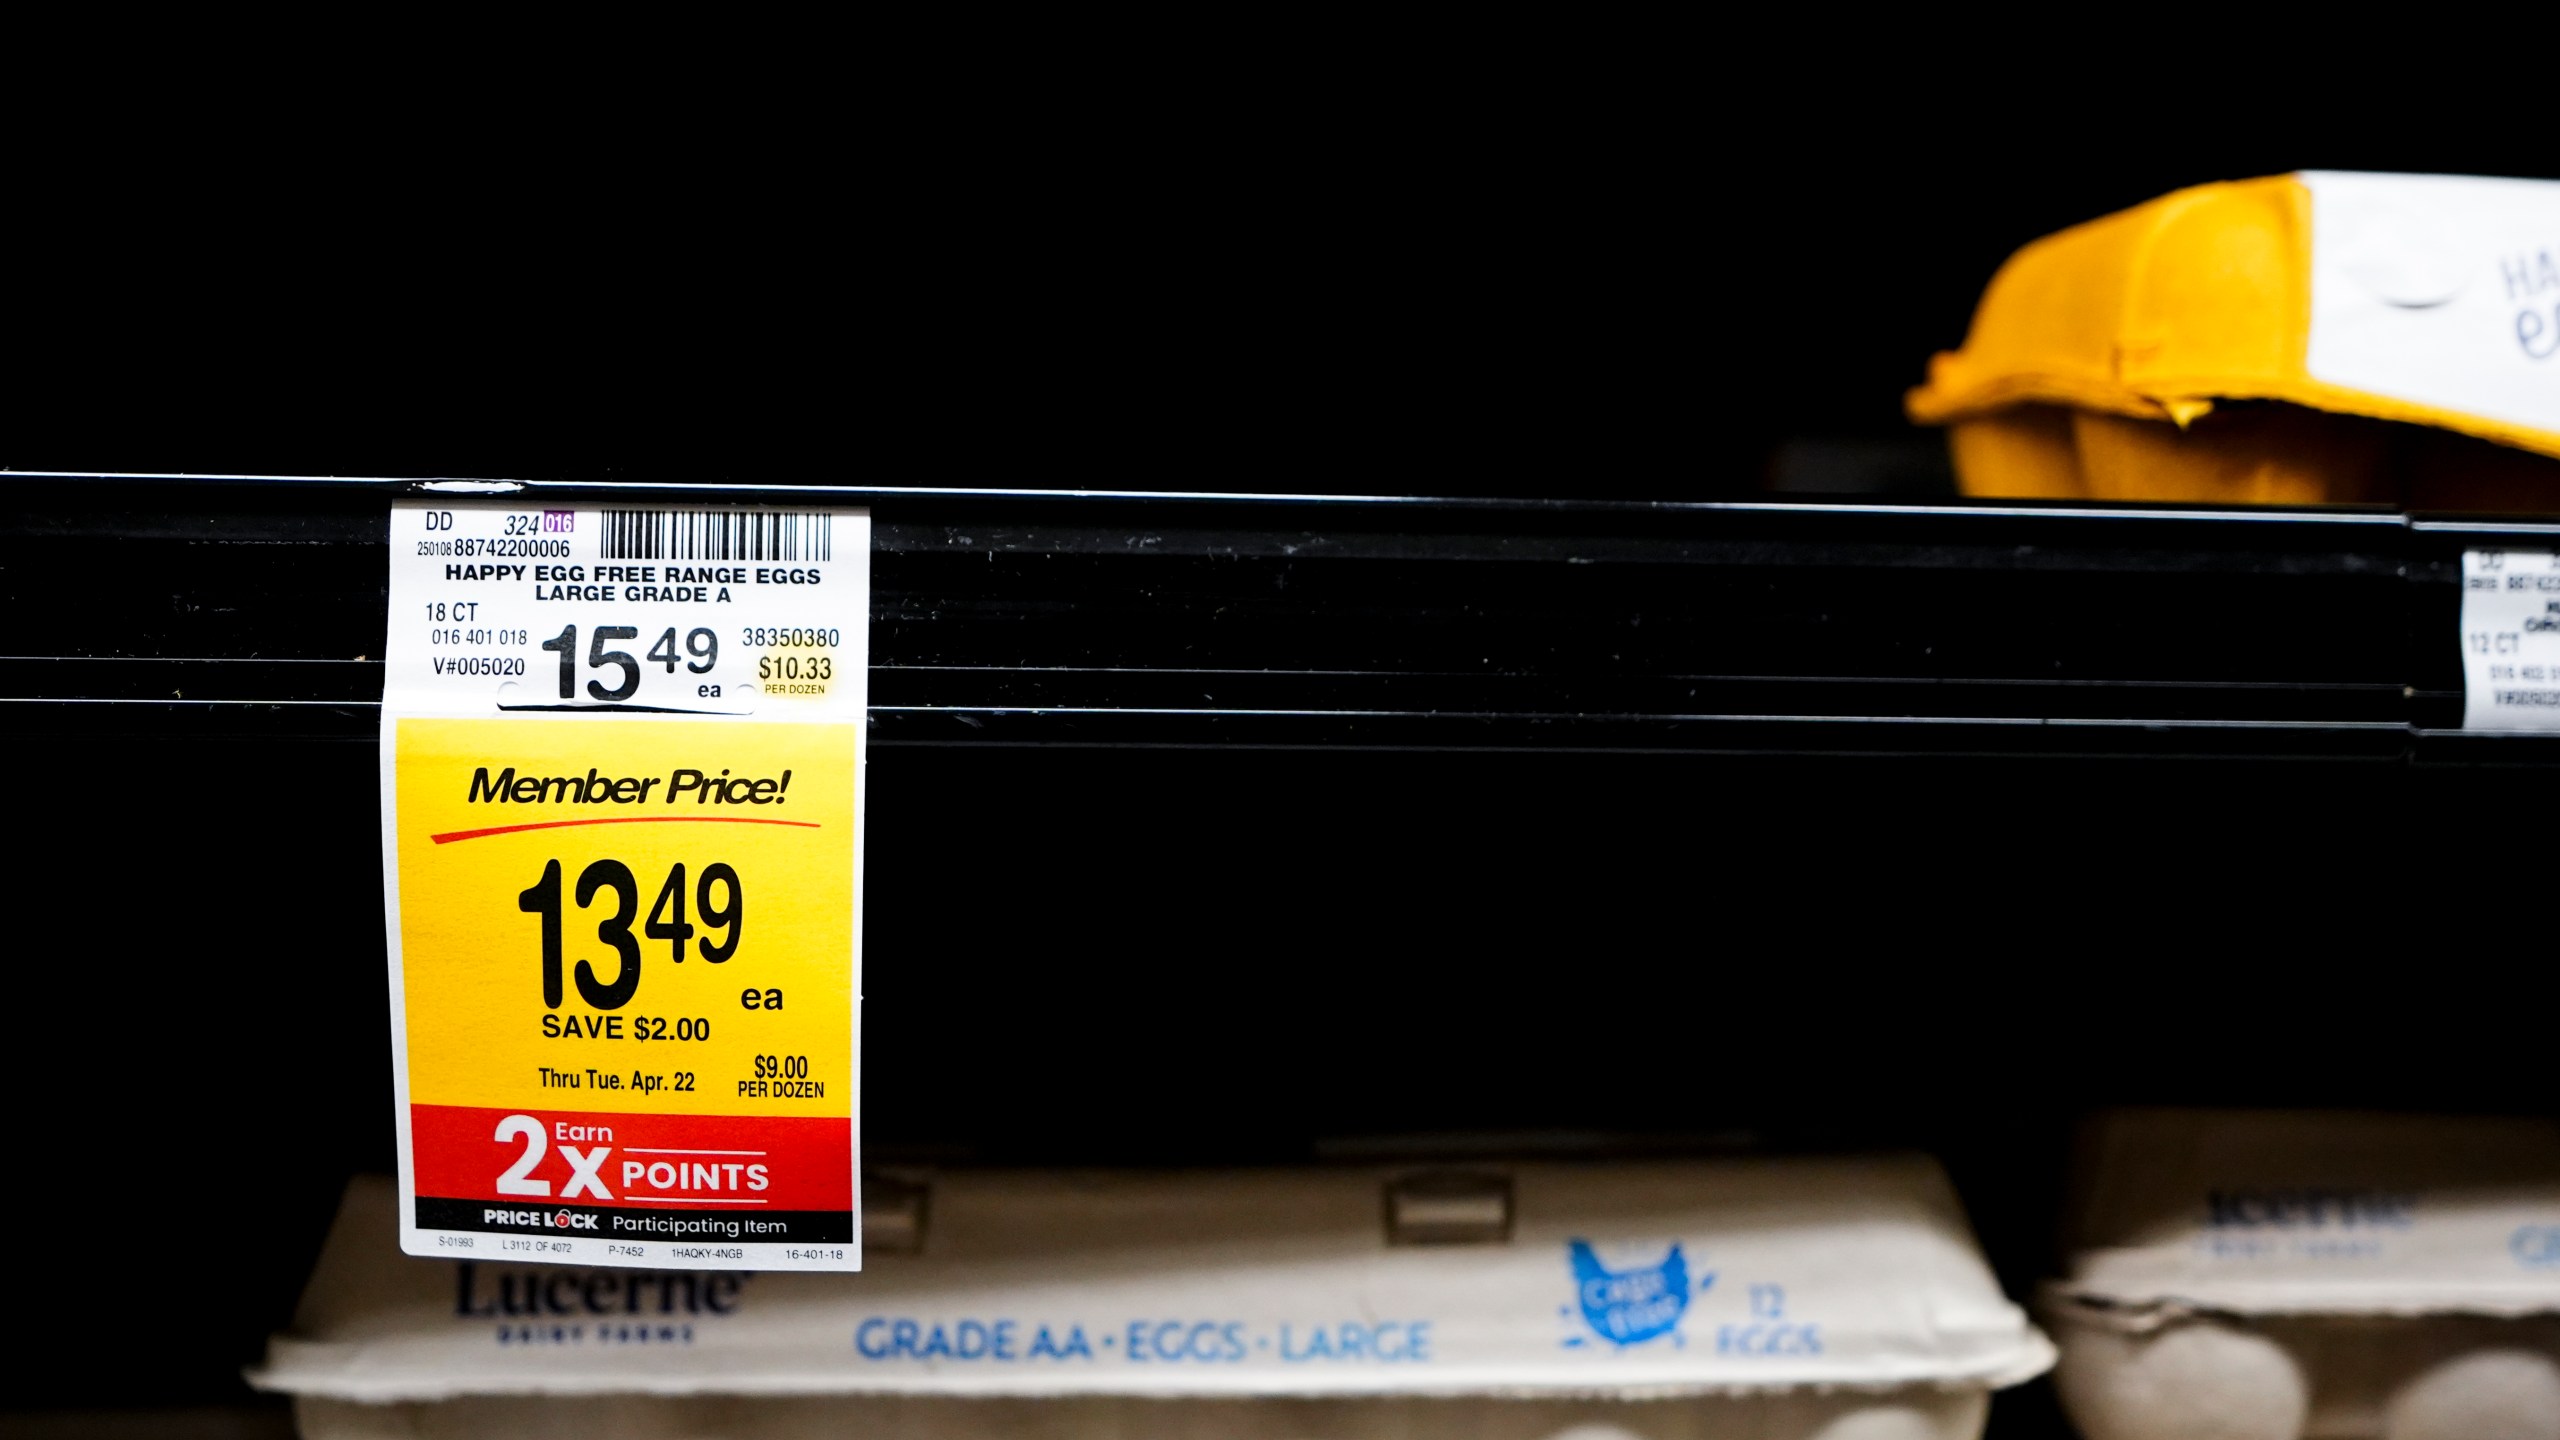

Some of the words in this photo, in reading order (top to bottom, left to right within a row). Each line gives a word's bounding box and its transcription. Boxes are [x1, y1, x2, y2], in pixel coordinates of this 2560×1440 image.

[426, 511, 453, 531] DD
[504, 515, 540, 536] 324
[544, 512, 574, 532] 016
[417, 541, 452, 556] 250108
[454, 538, 570, 558] 88742200006
[445, 564, 526, 581] HAPPY
[534, 565, 585, 582] EGG
[594, 566, 656, 583] FREE
[664, 567, 746, 584] RANGE
[755, 569, 821, 585] EGGS
[535, 585, 616, 601] LARGE
[625, 586, 708, 602] GRADE
[715, 587, 732, 603] A
[426, 602, 446, 621] 18
[452, 602, 478, 621] CT
[432, 629, 460, 645] 016
[466, 629, 492, 645] 401
[499, 629, 527, 645] 018
[742, 627, 840, 647] 38350380
[433, 657, 526, 676] V#005020
[758, 654, 832, 681] $10.33
[697, 684, 721, 698] ea
[765, 684, 786, 694] PER
[789, 684, 825, 694] DOZEN
[468, 767, 660, 804] Member
[665, 769, 792, 804] Price!
[741, 988, 784, 1011] ea
[541, 1014, 624, 1040] SAVE
[633, 1017, 710, 1043] $2.00
[754, 1055, 808, 1080] $9.00
[539, 1067, 580, 1089] Thru
[586, 1069, 625, 1090] Tue.
[630, 1072, 669, 1097] Apr.
[674, 1073, 695, 1092] 22
[737, 1081, 769, 1099] PER
[772, 1081, 825, 1099] DOZEN
[555, 1121, 613, 1142] Earn
[622, 1161, 770, 1191] POINTS
[484, 1209, 541, 1227] PRICE
[612, 1216, 740, 1238] Participating
[744, 1219, 788, 1233] Item
[438, 1236, 474, 1248] S-01993
[535, 1241, 548, 1252] OF
[551, 1242, 572, 1253] 4072
[608, 1245, 645, 1257] P-7452
[785, 1250, 844, 1260] 16-401-18
[855, 1318, 1017, 1360] GRADE
[1024, 1322, 1094, 1360] AA
[1125, 1320, 1247, 1361] EGGS
[1278, 1320, 1433, 1361] LARGE
